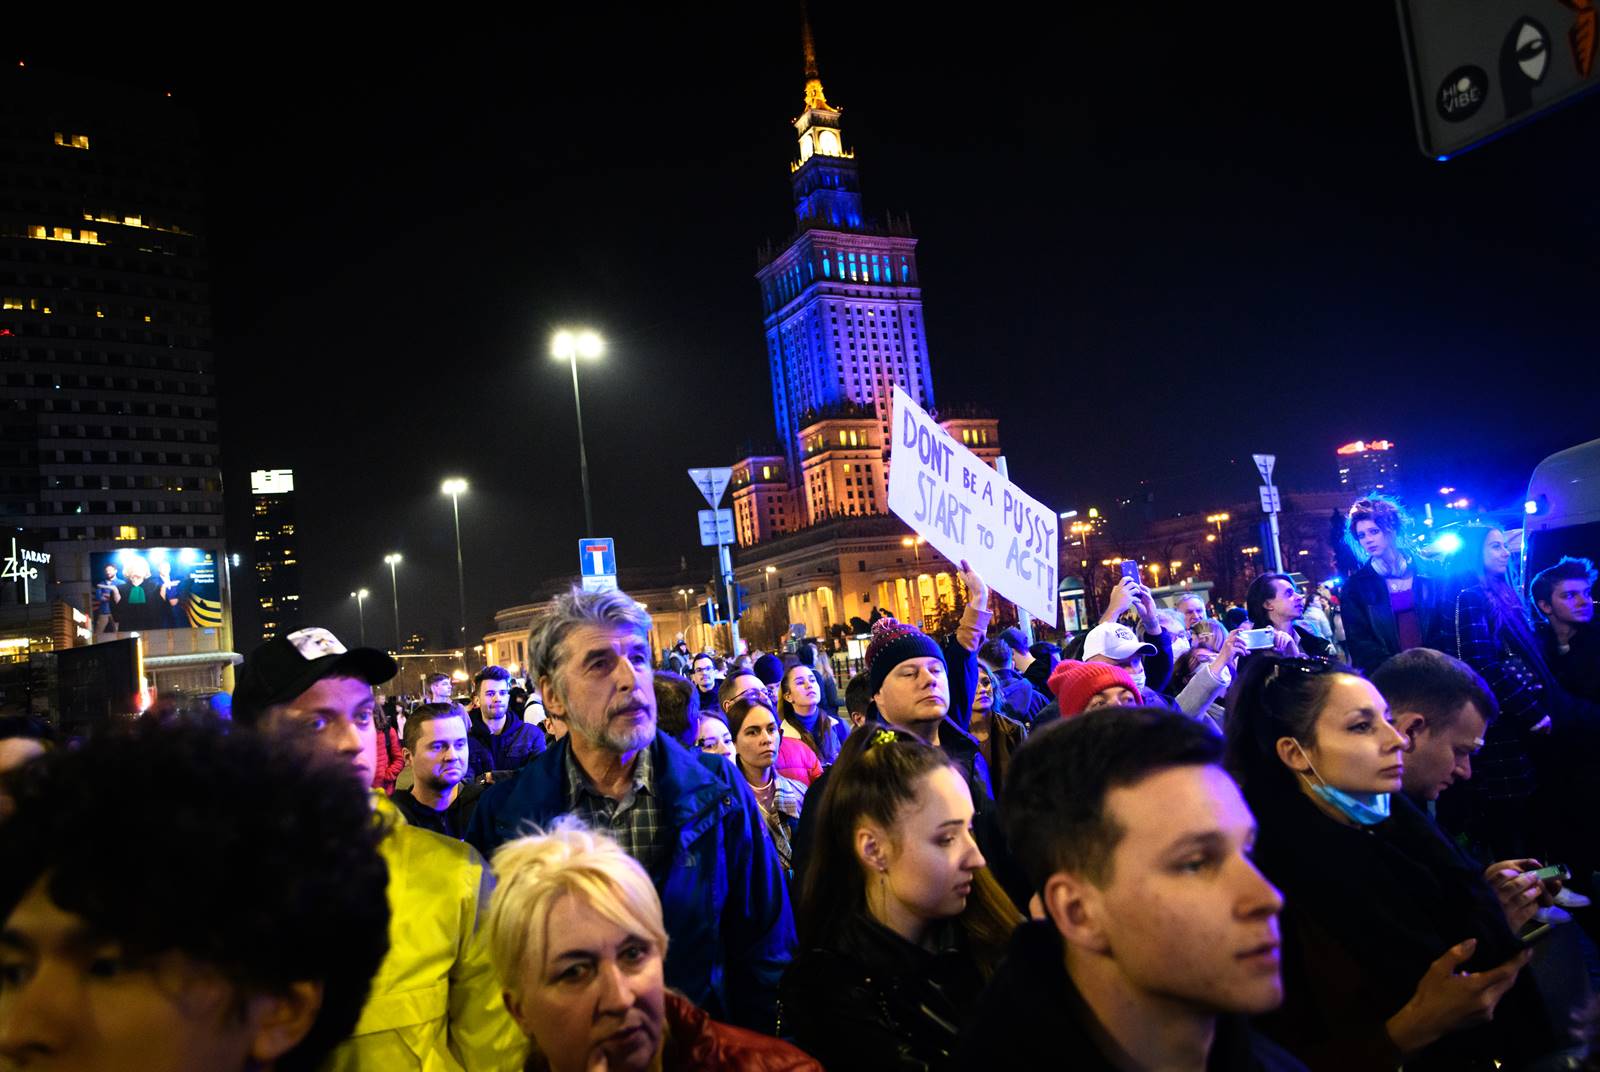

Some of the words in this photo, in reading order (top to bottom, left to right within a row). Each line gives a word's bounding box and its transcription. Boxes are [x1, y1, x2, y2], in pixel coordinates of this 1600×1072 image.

[1443, 86, 1479, 112] VIBE
[903, 406, 954, 482] DONT
[963, 467, 977, 494] BE
[982, 480, 993, 506] A
[1004, 488, 1055, 560] PUSSY
[20, 548, 51, 564] TARASY
[914, 471, 972, 545] START
[977, 524, 994, 550] TO
[1006, 537, 1055, 613] ACT!
